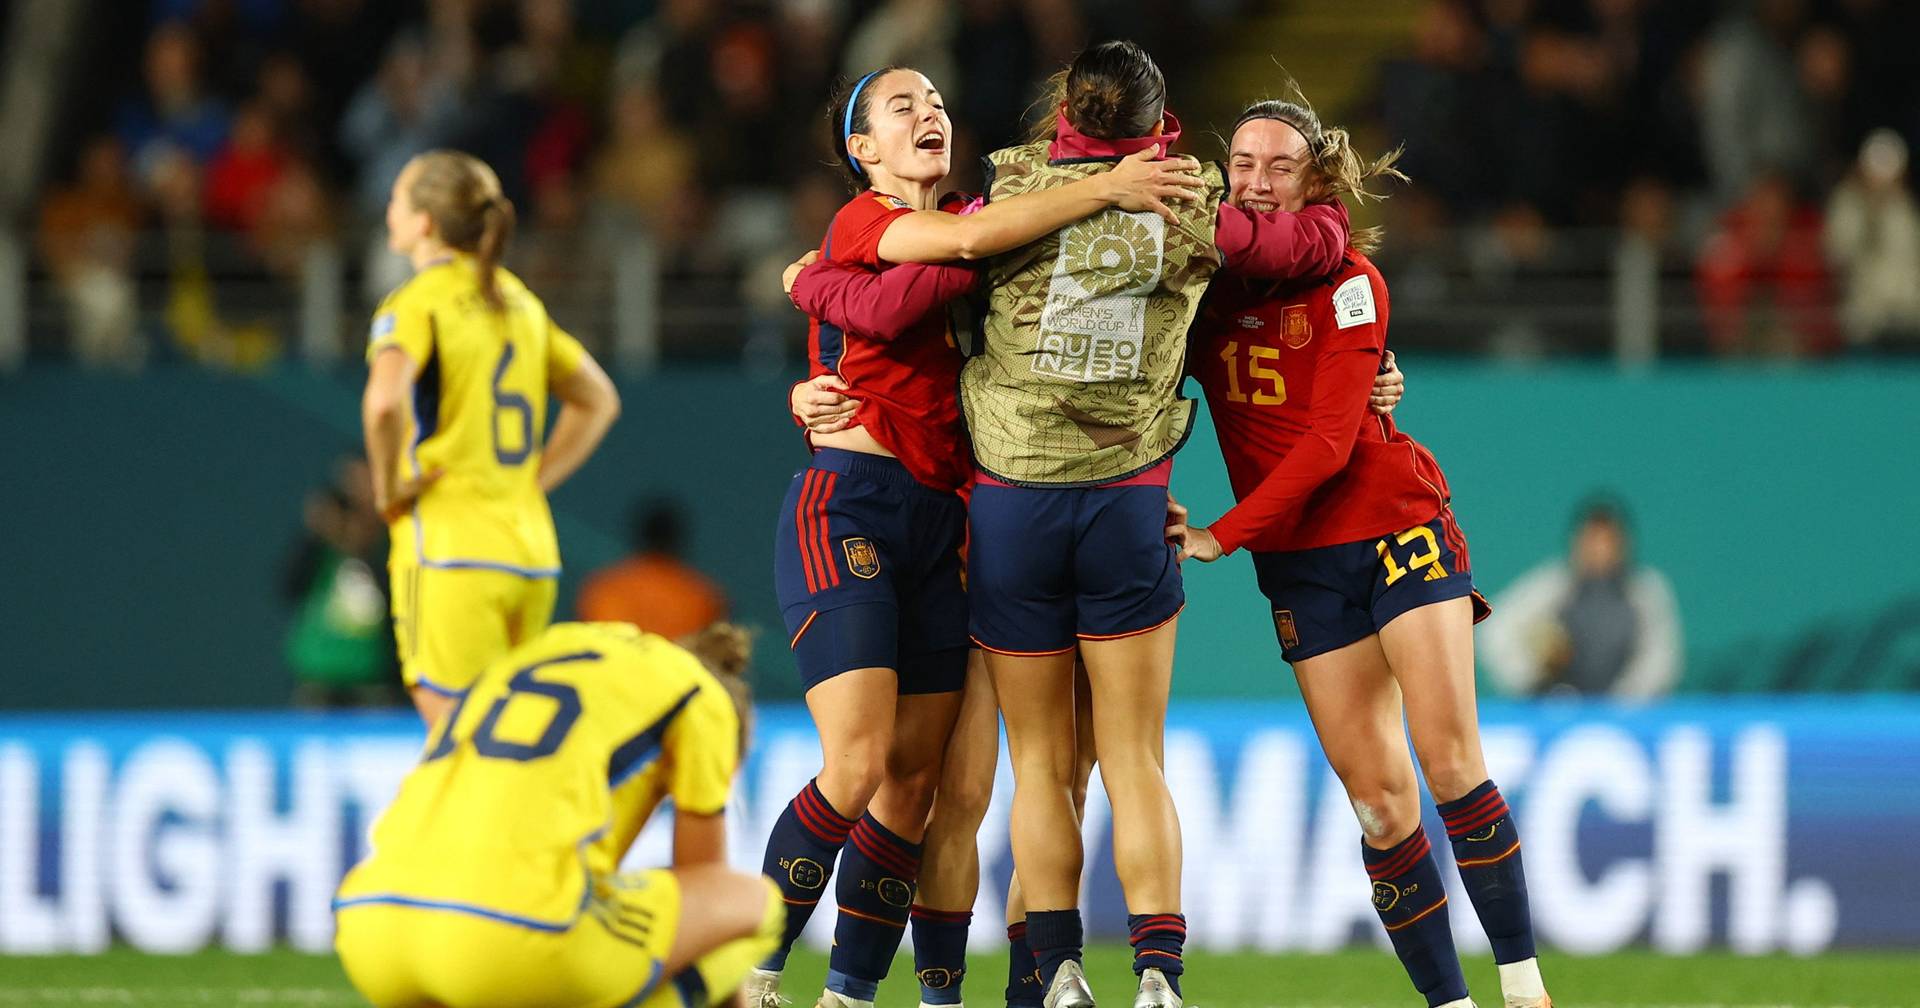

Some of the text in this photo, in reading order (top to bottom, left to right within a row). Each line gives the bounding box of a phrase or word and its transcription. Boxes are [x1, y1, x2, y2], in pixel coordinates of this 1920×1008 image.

[1047, 317, 1124, 332] WORLD CUP
[1095, 339, 1136, 360] 20
[1220, 341, 1287, 405] 15
[491, 340, 533, 466] 6
